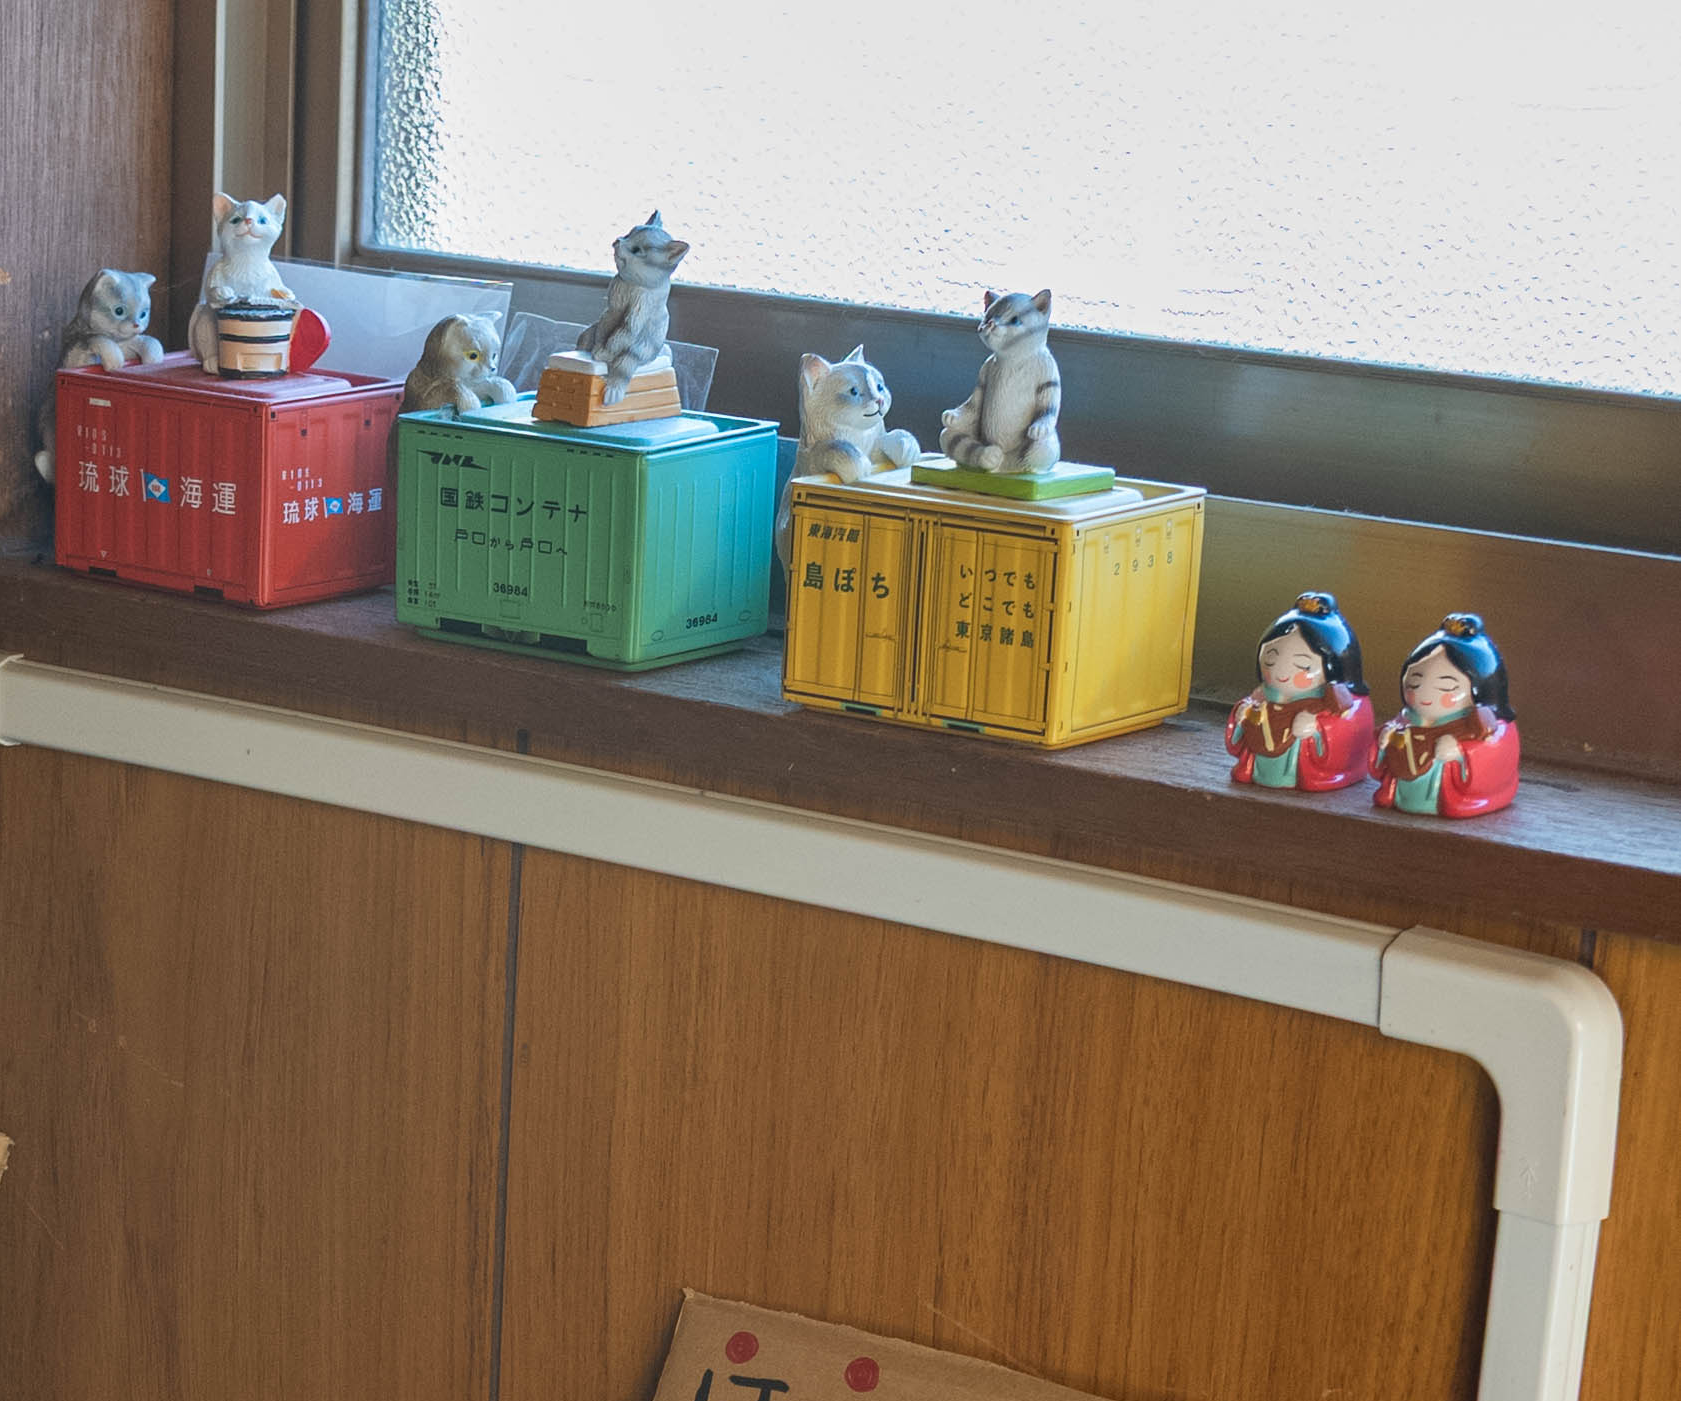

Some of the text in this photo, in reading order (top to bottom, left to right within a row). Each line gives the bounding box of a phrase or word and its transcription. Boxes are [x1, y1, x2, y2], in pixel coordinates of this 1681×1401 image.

[78, 460, 236, 515] 琉球 海運
[282, 487, 383, 524] 琉球 海運
[439, 487, 588, 523] 国鉄コンテナ
[453, 528, 568, 556] 戸口から戸口へ
[959, 563, 1037, 591] いつでも
[1113, 549, 1174, 577] 2938
[802, 561, 890, 599] 島ぽち
[685, 612, 719, 629] 36984
[958, 592, 1036, 620] どこでも
[955, 620, 1036, 650] 東京諸島
